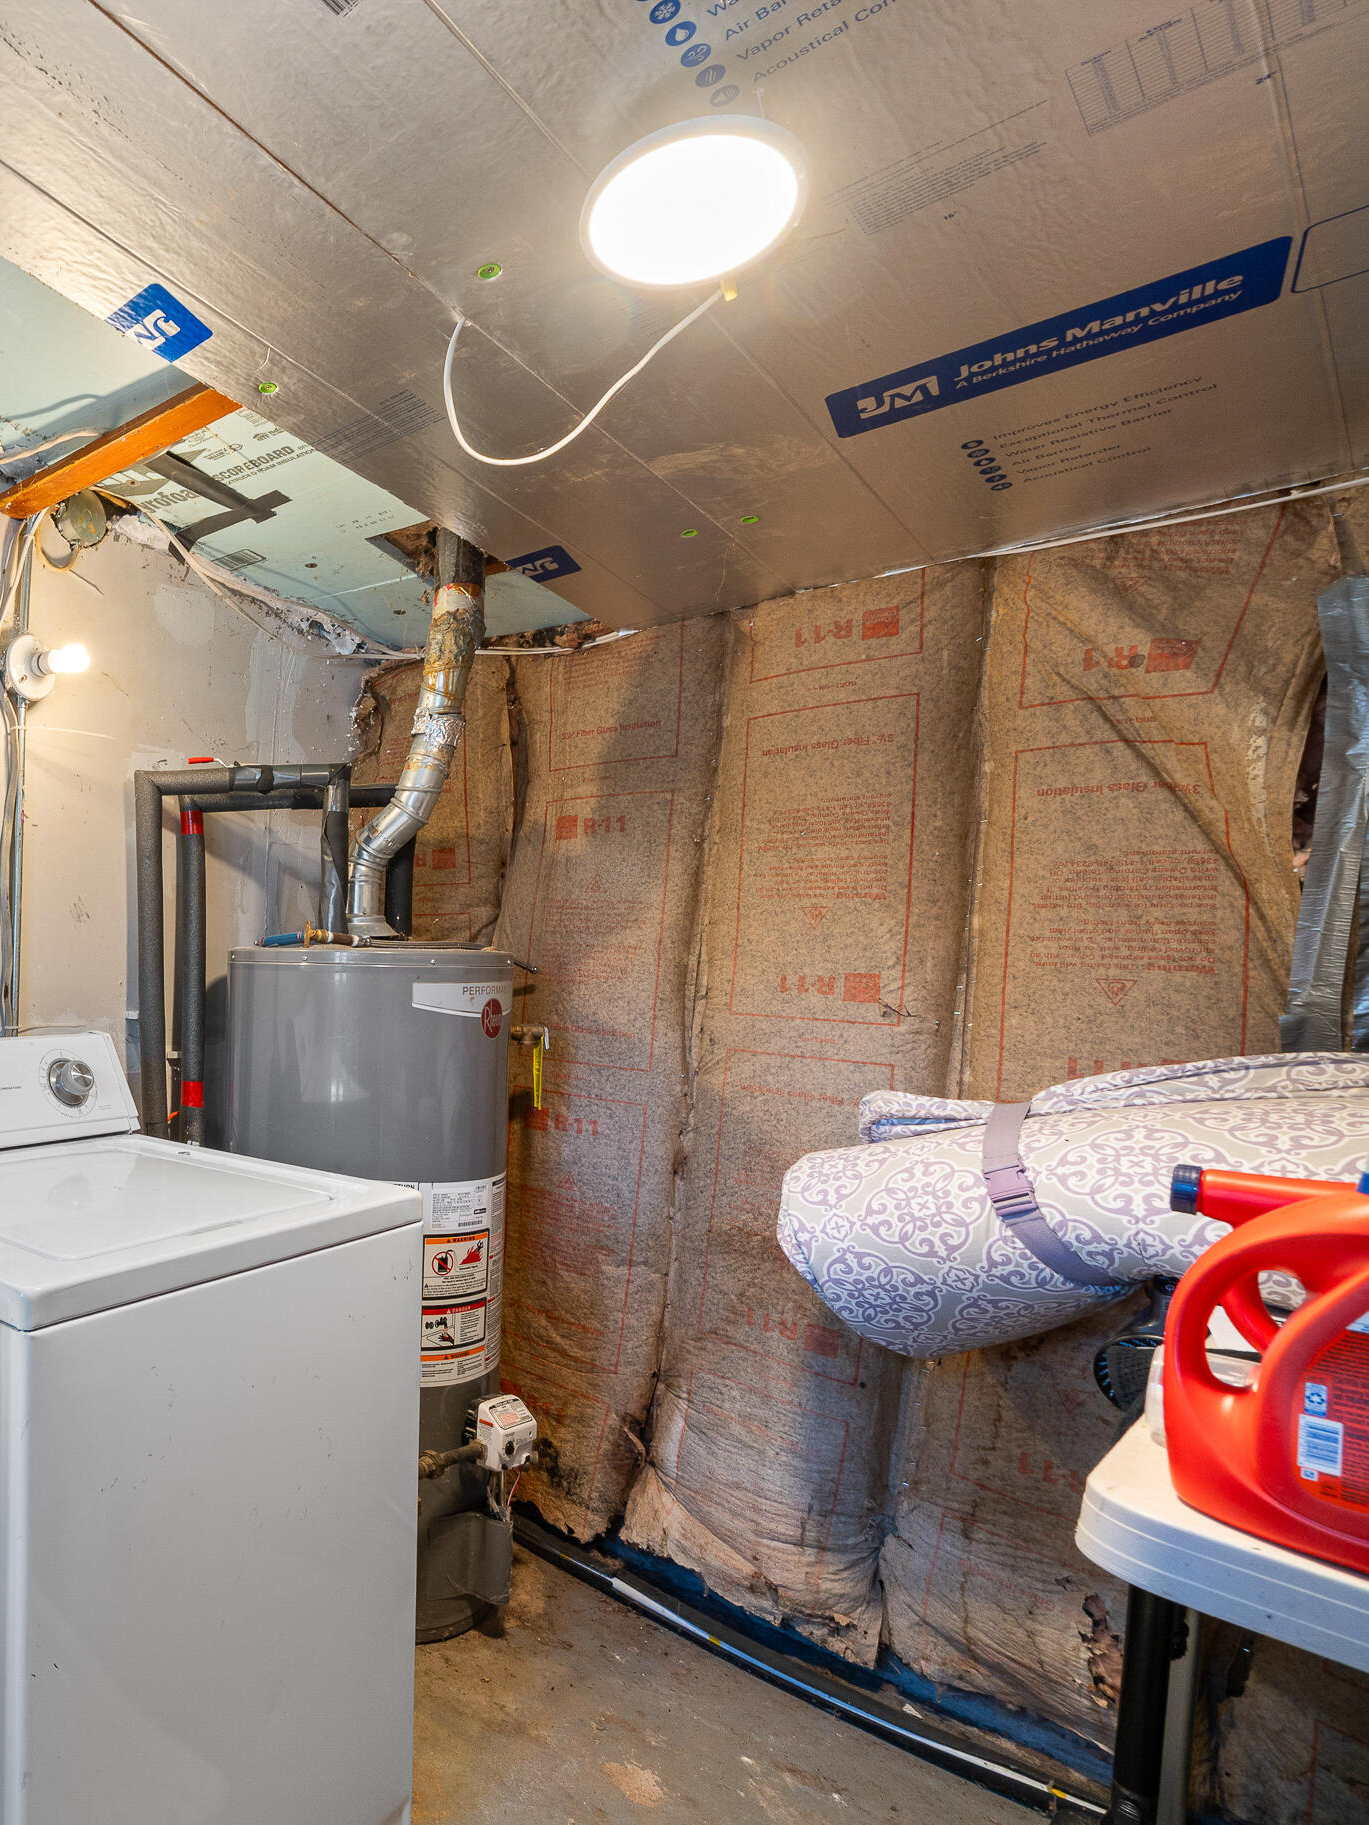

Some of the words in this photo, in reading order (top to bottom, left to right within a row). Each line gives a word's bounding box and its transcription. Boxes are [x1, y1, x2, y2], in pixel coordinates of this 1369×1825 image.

[725, 20, 750, 41] Air
[736, 26, 791, 61] Vapor
[753, 20, 849, 83] Acoustical
[954, 337, 1060, 381] Johns
[1065, 275, 1244, 342] Manville
[956, 380, 968, 389] A
[973, 354, 1048, 383] Berkshire
[1052, 323, 1143, 358] Hathaway
[1148, 290, 1242, 327] Company
[856, 375, 940, 420] JM
[993, 418, 1061, 439] Improves
[1065, 402, 1118, 419] Energy
[1123, 377, 1202, 402] Efficiency
[1000, 422, 1082, 448] Exceptional
[1087, 403, 1151, 422] Thermal
[1156, 384, 1217, 404] Control
[1005, 444, 1045, 457] Water
[1051, 425, 1116, 445] Resistive
[1121, 409, 1172, 426] Barrier
[213, 446, 295, 482] SCOREBOARD
[1017, 462, 1055, 474] Vapor
[1061, 445, 1120, 463] Retarder
[1023, 462, 1093, 483] Acoustical
[1097, 446, 1151, 463] Control
[1035, 445, 1081, 460] Barrier
[795, 618, 853, 648] R-11
[576, 728, 594, 738] Fiber
[596, 725, 618, 735] Glass
[620, 719, 662, 731] Insulation
[842, 736, 869, 747] Fiber
[762, 744, 808, 758] Insulation
[811, 739, 839, 751] Glass
[1037, 784, 1103, 798] Insulation
[1107, 781, 1147, 792] Glass
[583, 815, 626, 835] R-11
[1141, 963, 1215, 975] Warning:
[780, 974, 836, 995] R-11
[554, 1114, 599, 1137] R-11
[745, 1307, 797, 1341] R-11
